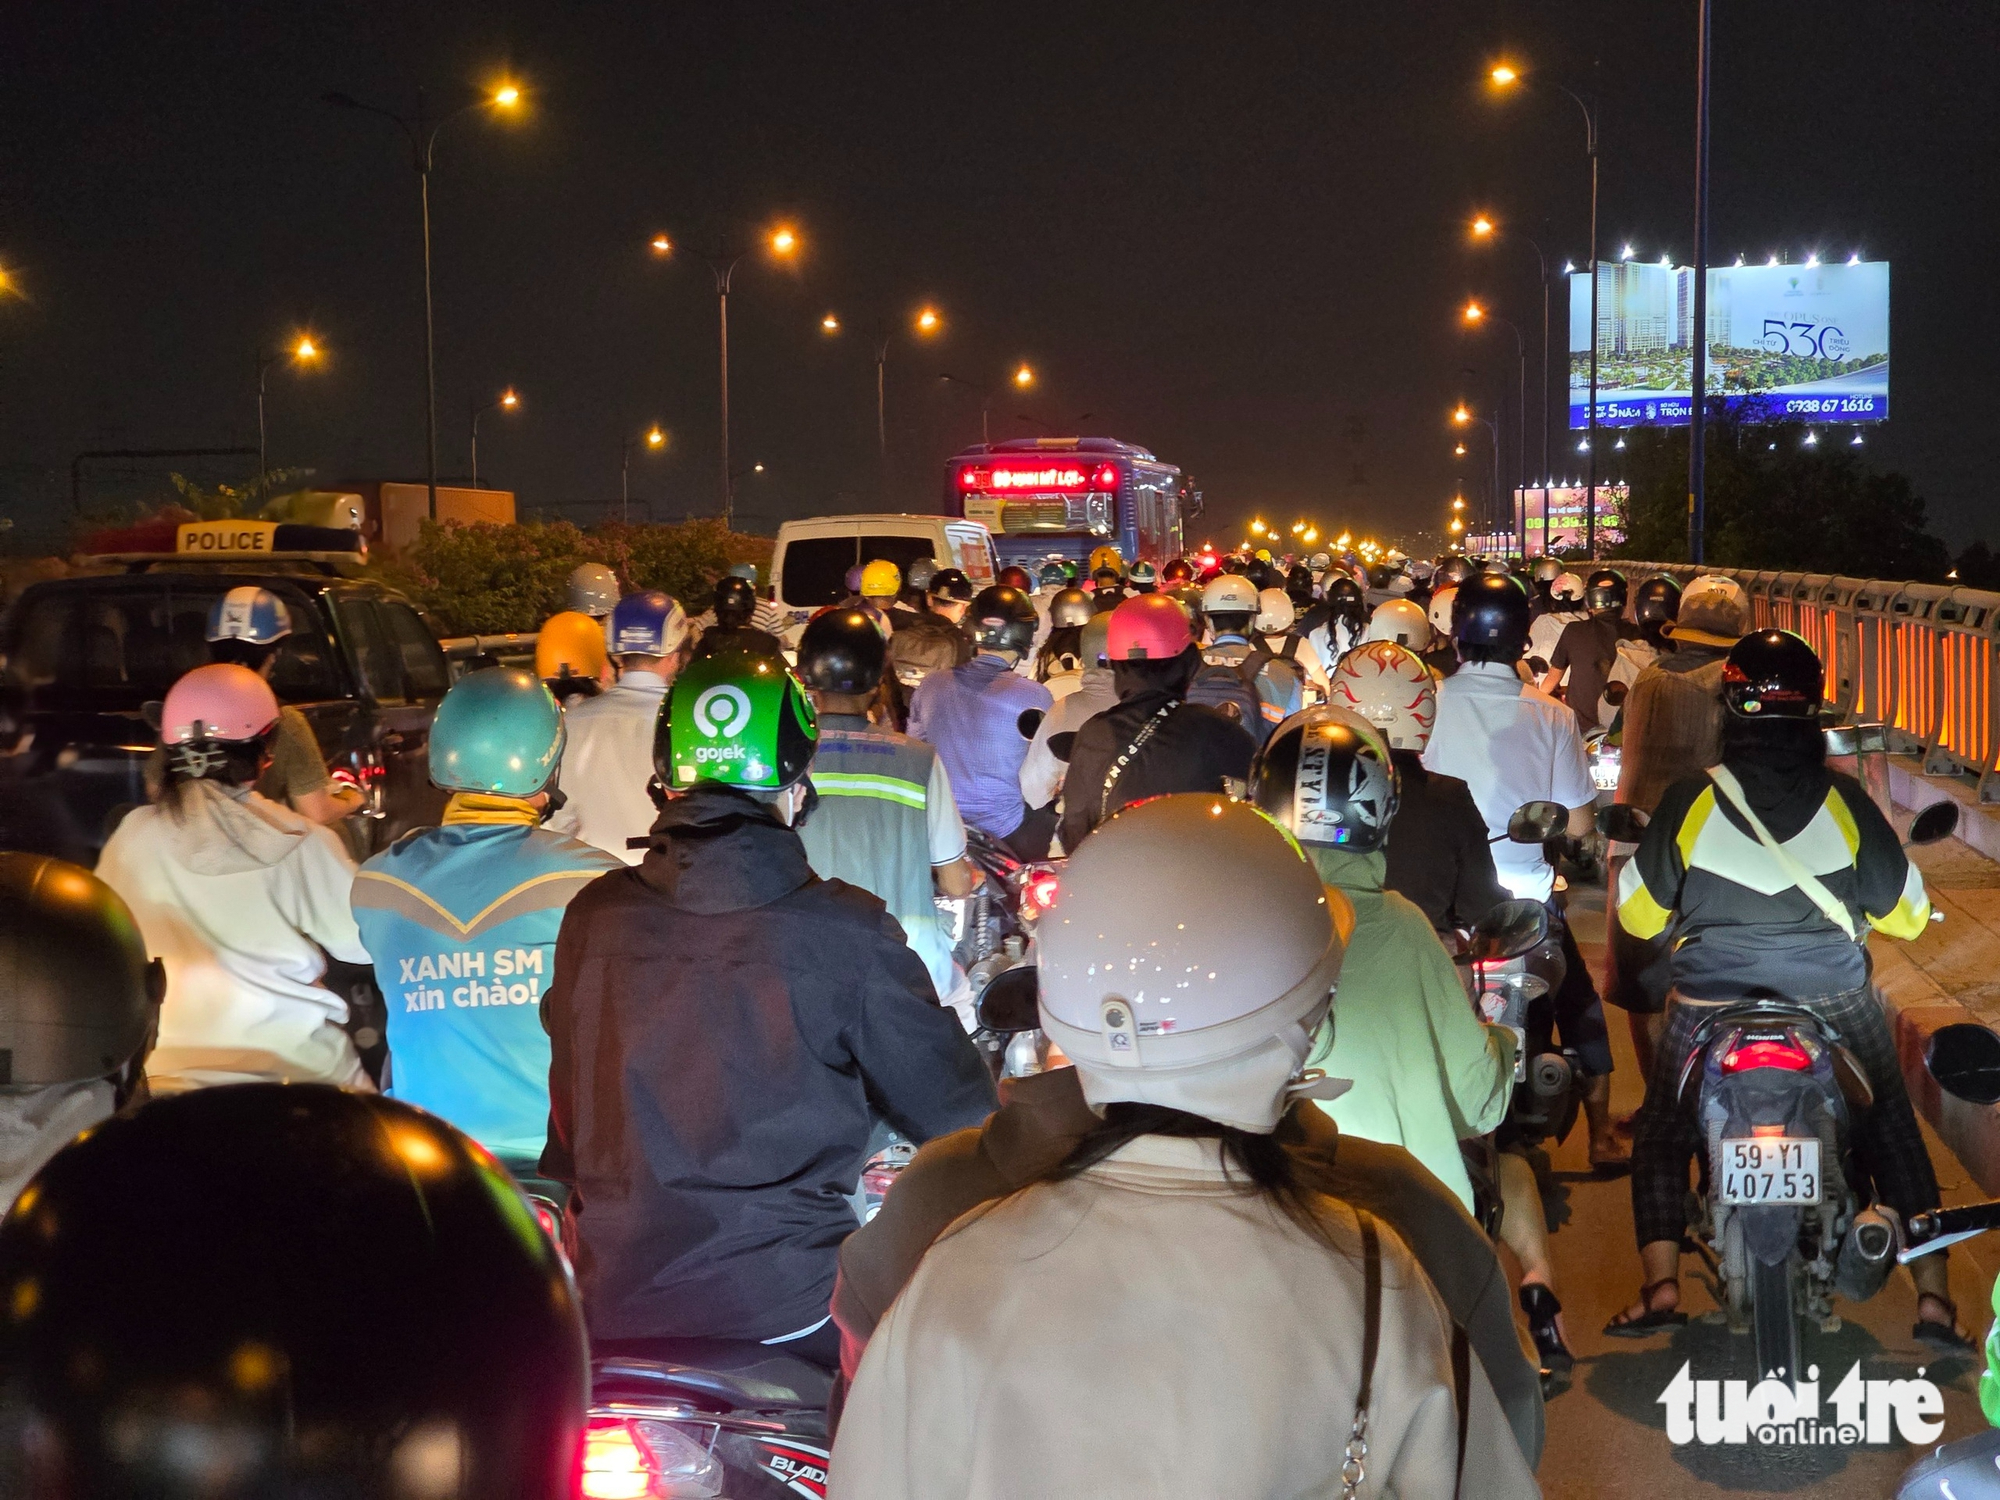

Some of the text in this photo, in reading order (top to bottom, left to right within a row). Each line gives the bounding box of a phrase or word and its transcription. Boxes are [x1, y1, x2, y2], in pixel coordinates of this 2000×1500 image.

[1784, 312, 1820, 323] OPUS
[1608, 404, 1618, 418] 5
[1661, 408, 1686, 417] TRỌN
[1821, 400, 1839, 412] 67
[1841, 399, 1874, 412] 1616
[186, 532, 264, 550] POLICE
[695, 744, 746, 763] gojek
[399, 949, 543, 984] XANH SM
[404, 977, 540, 1013] xin chào!
[1726, 1173, 1816, 1199] 407.53
